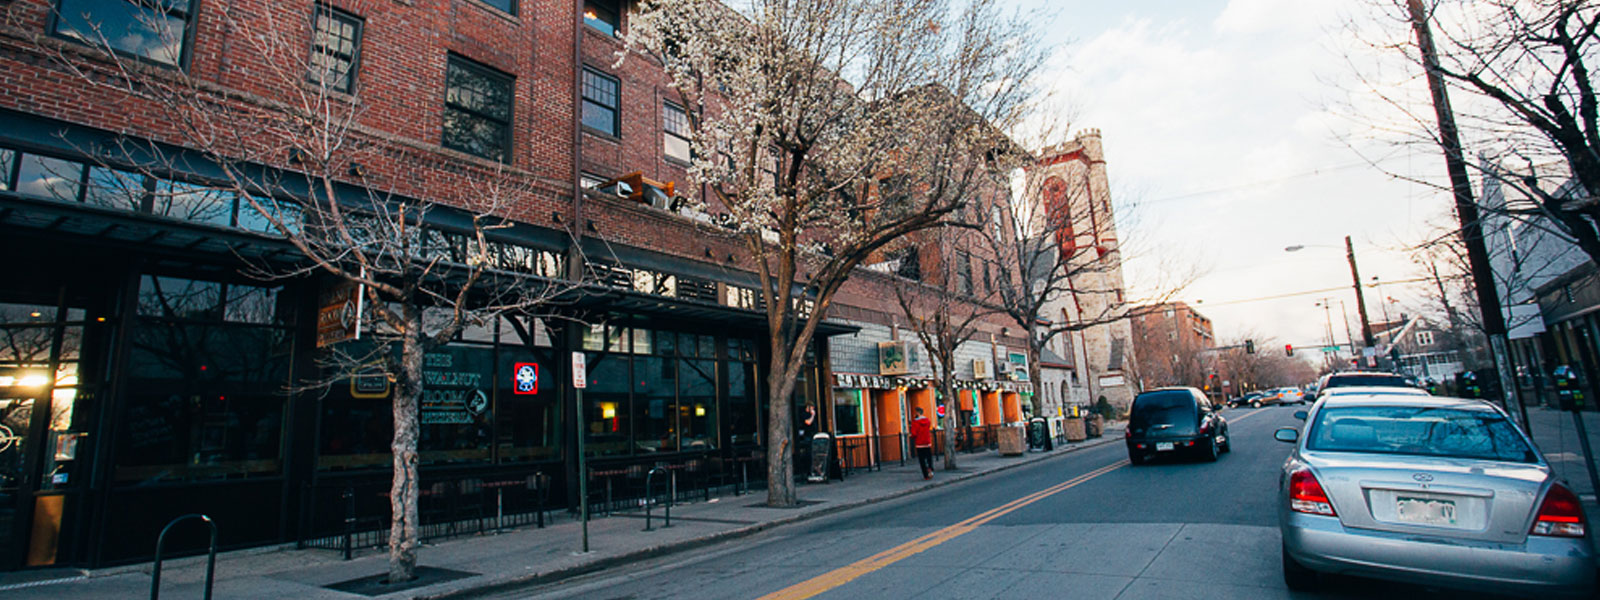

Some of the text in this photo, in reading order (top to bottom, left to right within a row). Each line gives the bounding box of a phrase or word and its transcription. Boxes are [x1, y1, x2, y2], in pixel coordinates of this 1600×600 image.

[424, 353, 452, 367] THE
[423, 371, 481, 387] WALNUT
[423, 390, 466, 402] ROOM
